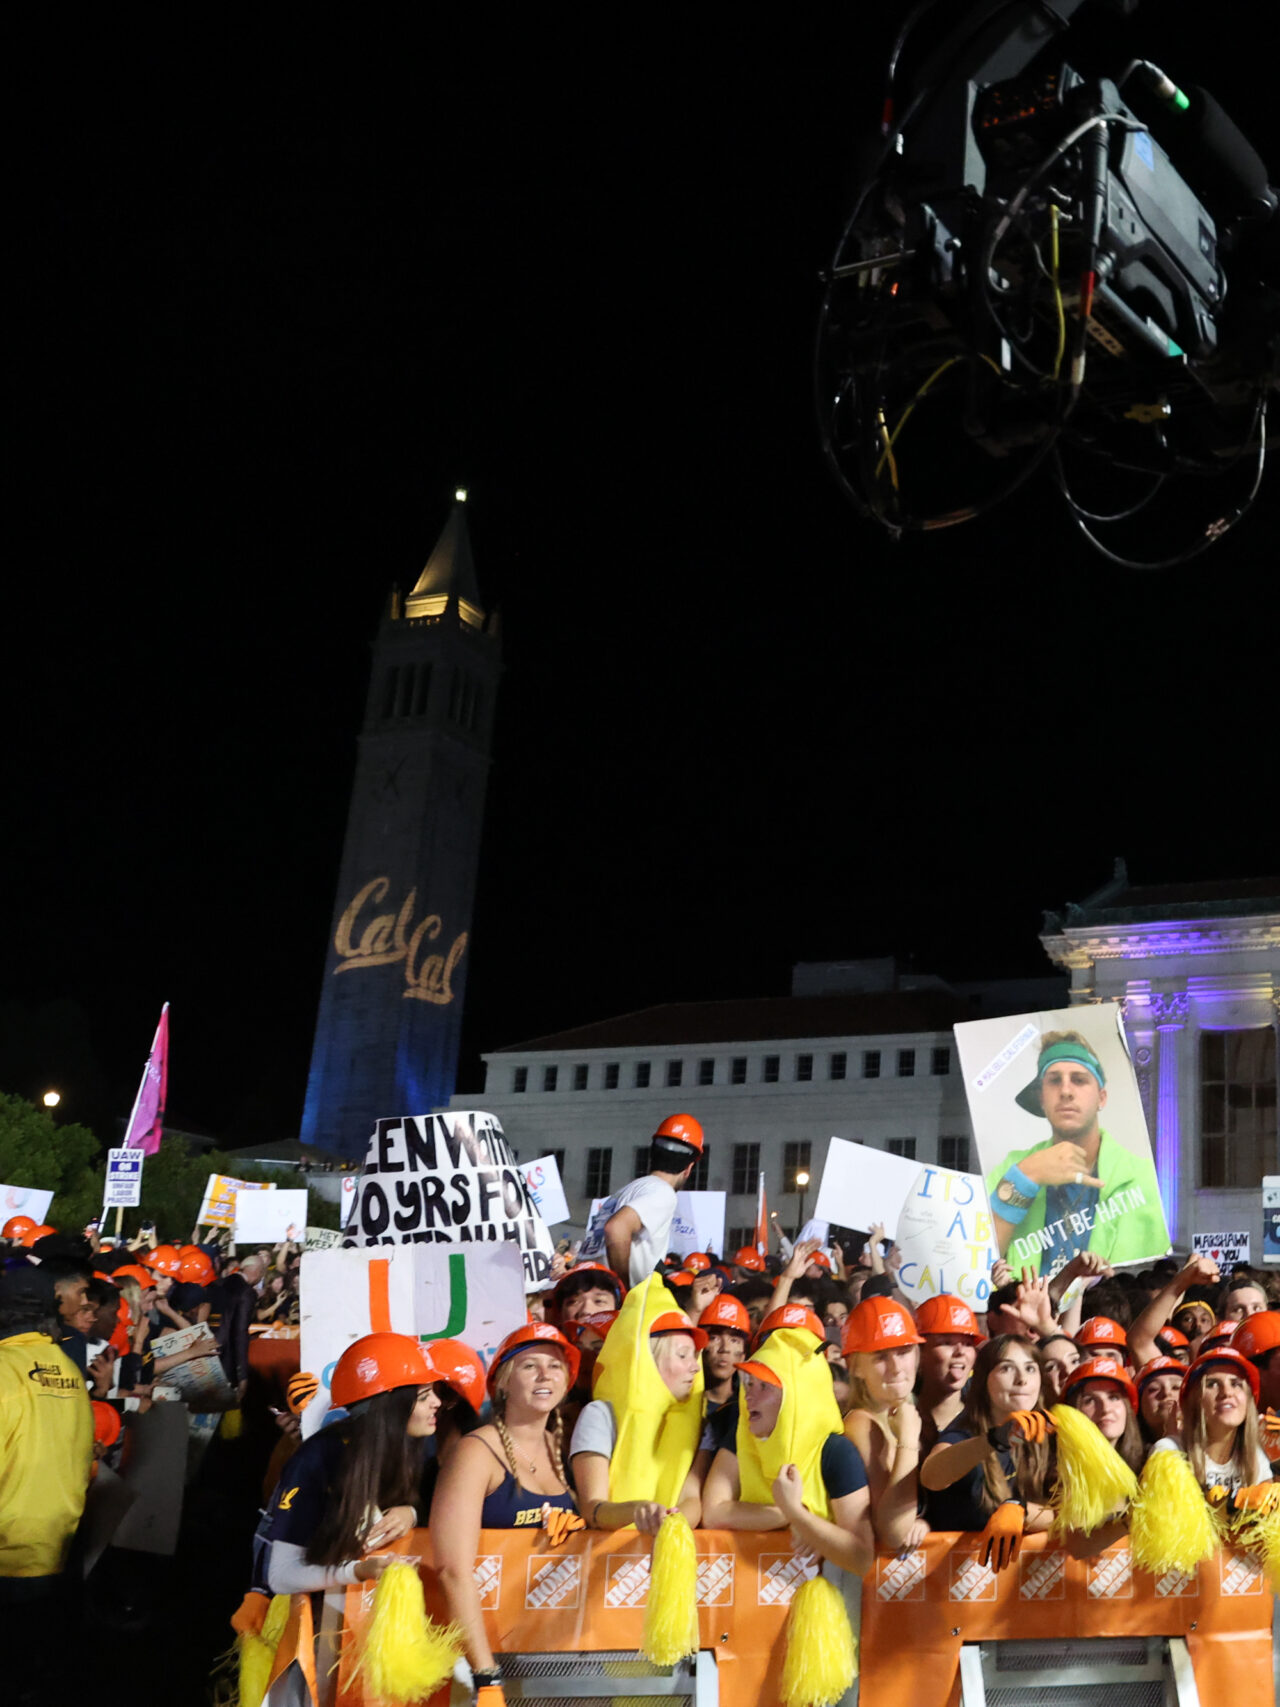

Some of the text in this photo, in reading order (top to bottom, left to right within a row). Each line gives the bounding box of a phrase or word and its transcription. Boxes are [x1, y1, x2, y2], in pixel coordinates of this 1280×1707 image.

[334, 877, 417, 975] Cal
[403, 914, 468, 1005] Cal
[111, 1151, 141, 1160] UAW
[394, 1174, 471, 1231] YRS
[478, 1168, 543, 1223] FOR
[1014, 1186, 1147, 1260] DON'T BE HATIN
[1194, 1233, 1248, 1248] MARSHAWN
[1222, 1249, 1240, 1261] YOU
[368, 1253, 468, 1342] U
[527, 1555, 581, 1608] HOME
[533, 1561, 555, 1582] THE
[547, 1577, 580, 1608] DEPOT
[606, 1554, 652, 1607] HOM
[625, 1576, 652, 1607] DEPO
[696, 1555, 733, 1603] OME
[877, 1551, 926, 1600] HOME
[950, 1556, 993, 1600] HOM
[1087, 1549, 1132, 1598] HOME
